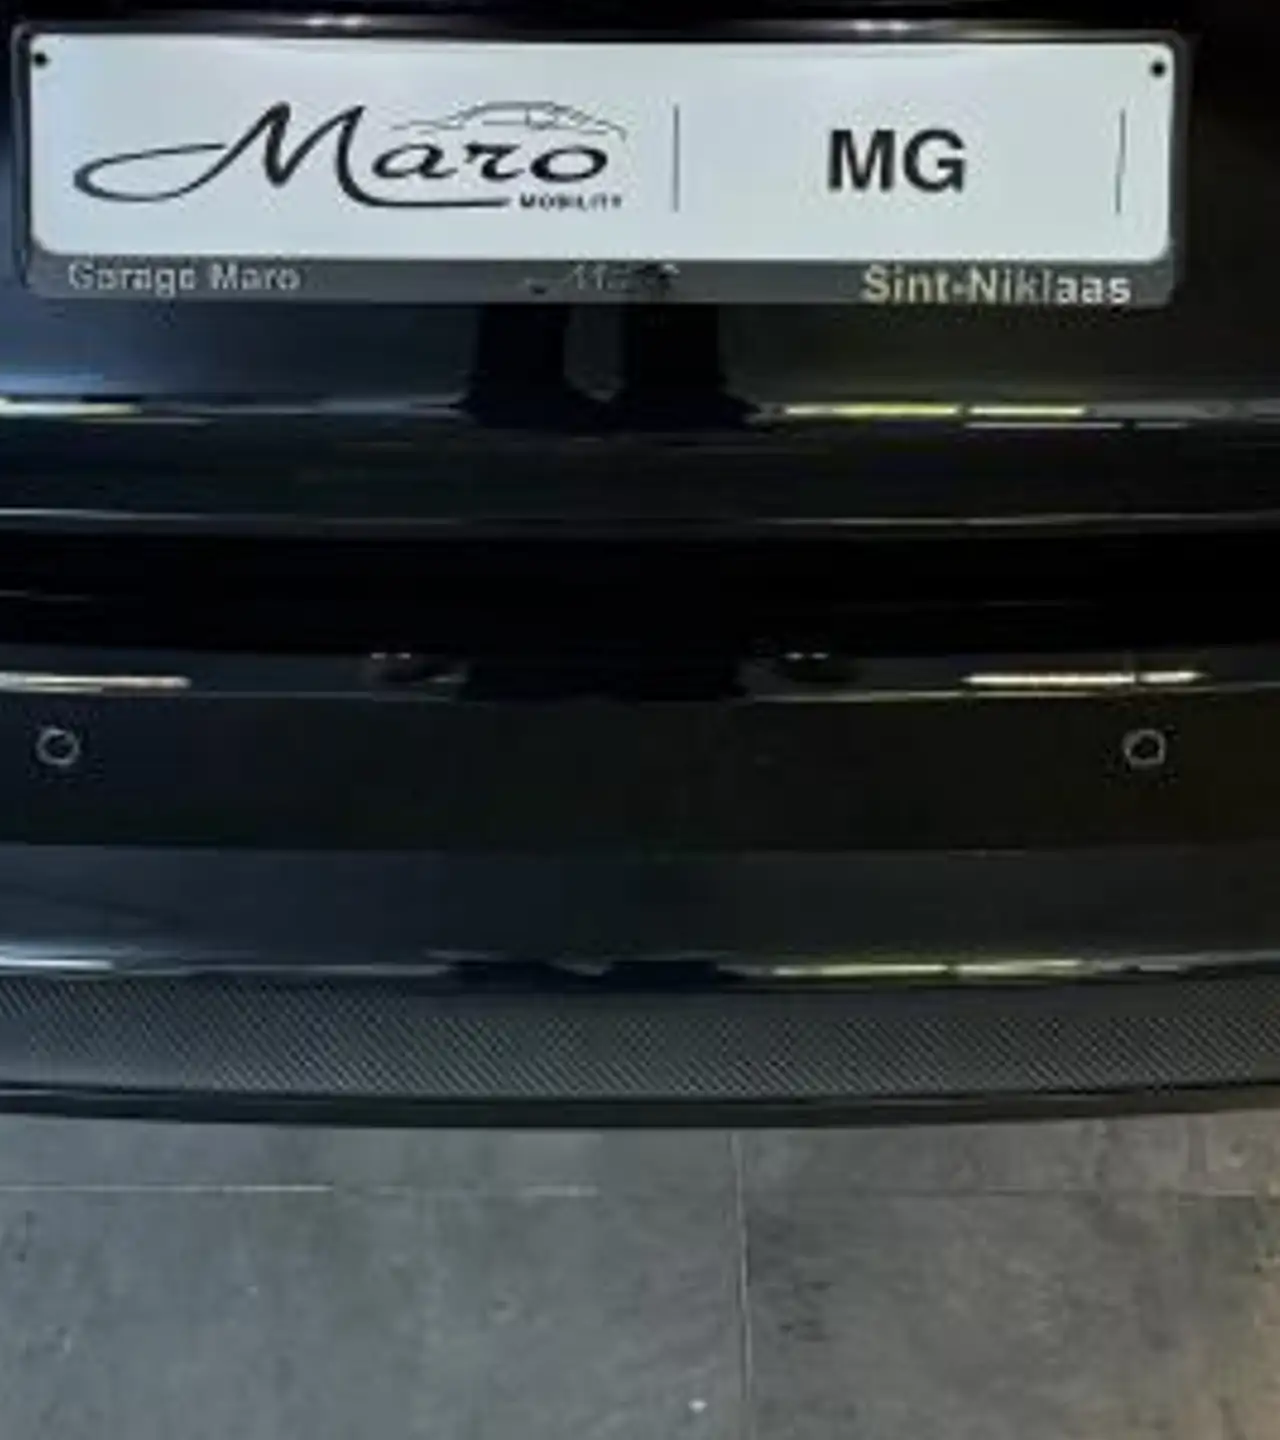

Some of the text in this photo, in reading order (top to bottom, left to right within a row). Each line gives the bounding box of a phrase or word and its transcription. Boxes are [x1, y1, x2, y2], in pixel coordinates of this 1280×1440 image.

[74, 101, 609, 209] Maro
[827, 128, 966, 194] MG
[519, 196, 622, 211] MOBILITY
[68, 260, 302, 298] Garage Maro
[862, 263, 1132, 304] Sint-Niklaas
